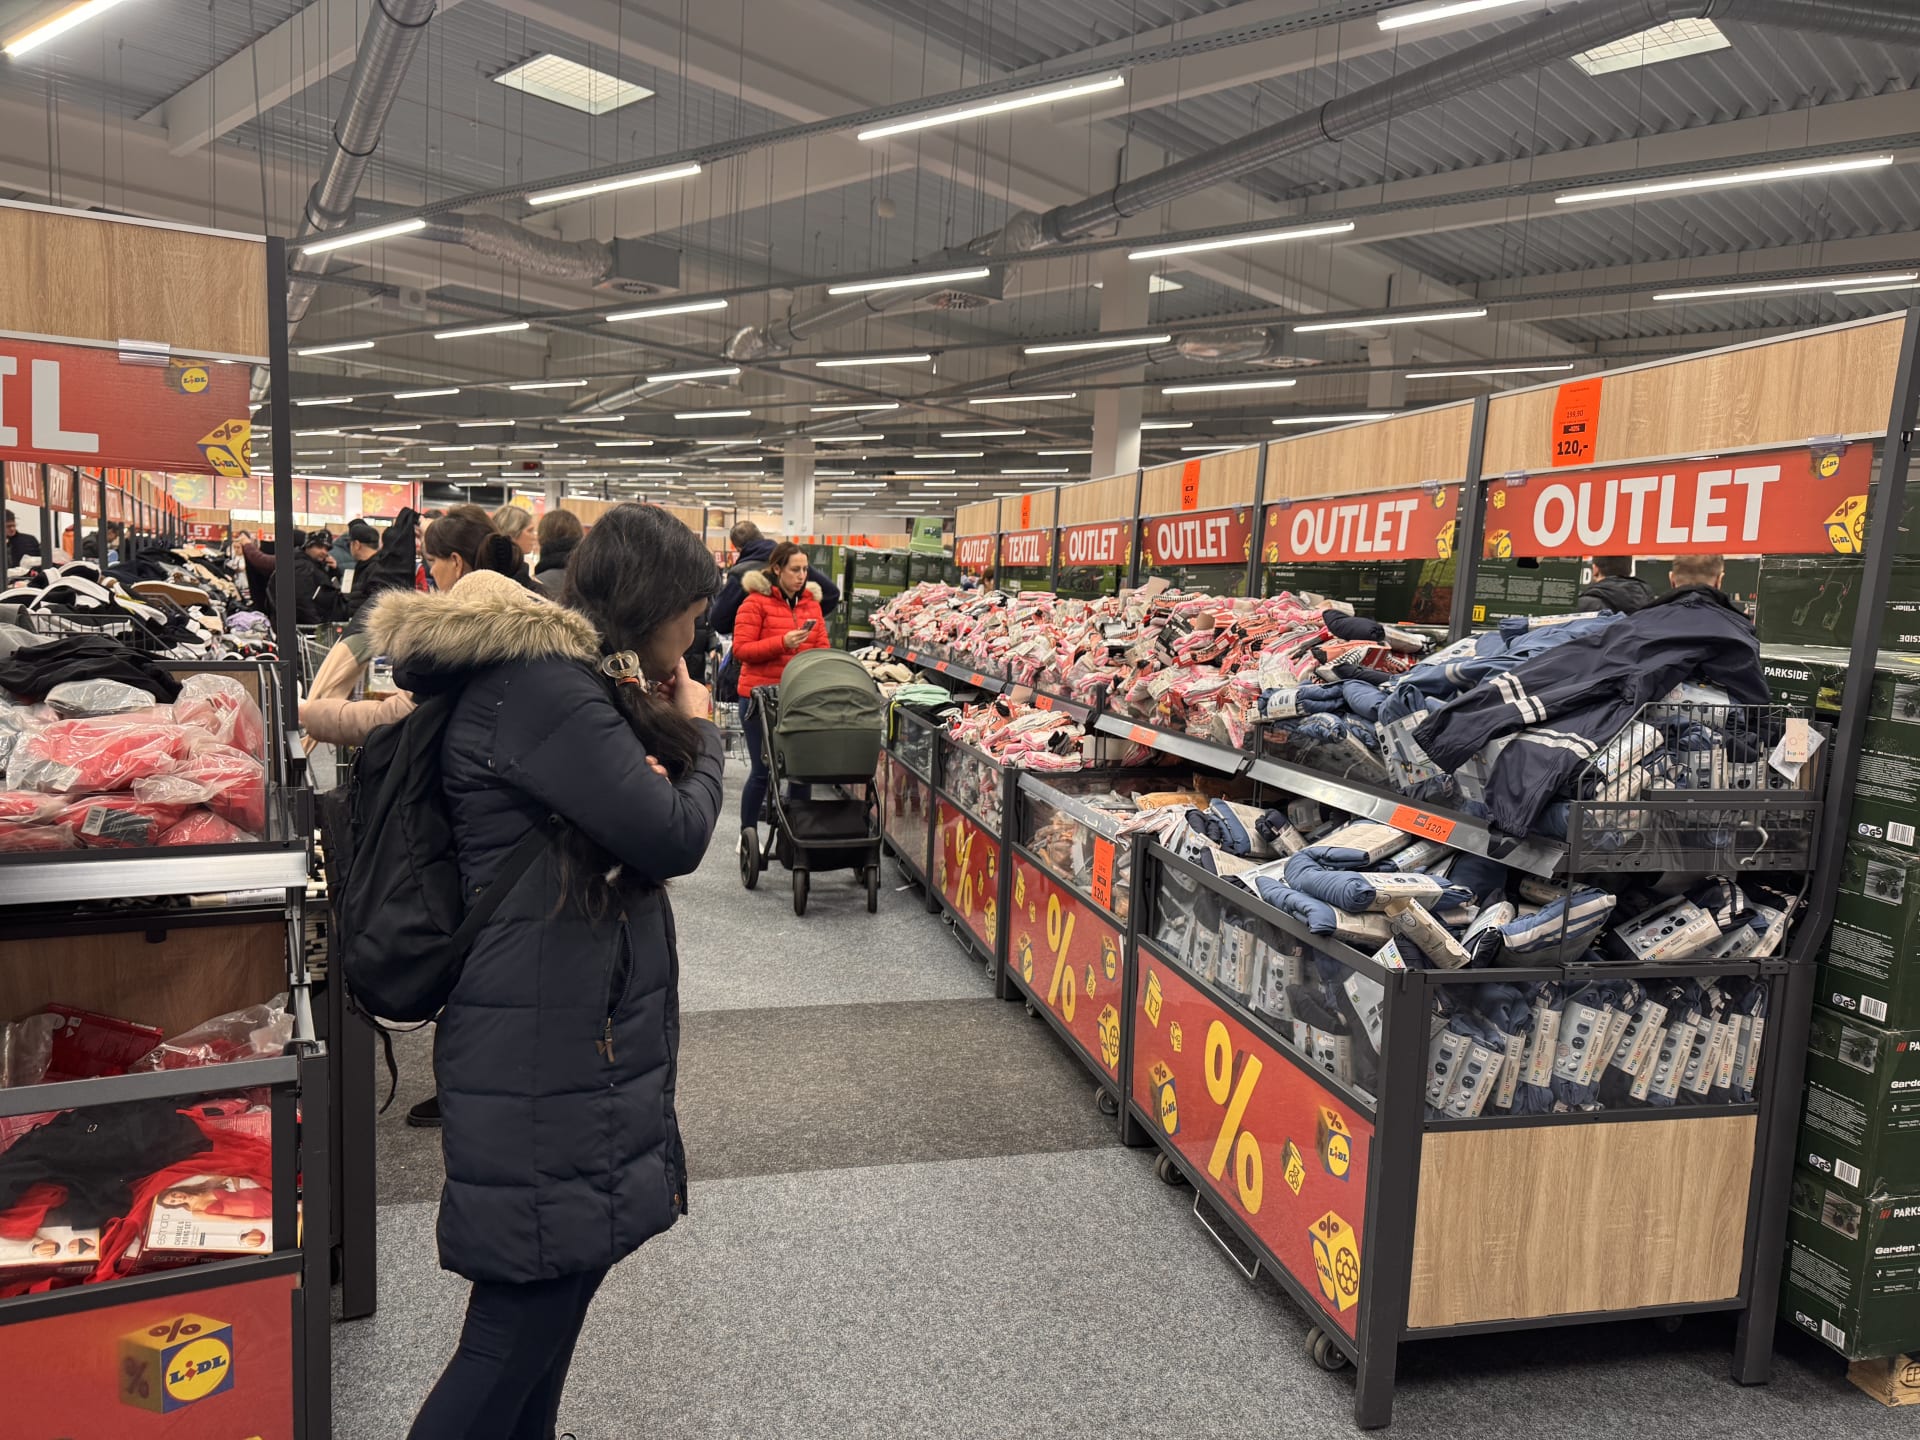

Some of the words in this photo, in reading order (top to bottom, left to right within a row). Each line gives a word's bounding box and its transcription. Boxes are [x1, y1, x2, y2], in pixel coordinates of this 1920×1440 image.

[1557, 440, 1589, 456] 120,-
[1533, 465, 1781, 548] OUTLET
[1157, 517, 1230, 560] OUTLET
[1290, 499, 1418, 555] OUTLET
[961, 539, 990, 563] OUTLET
[1009, 535, 1040, 562] TEXTIL
[1069, 528, 1118, 561] OUTLET
[1764, 666, 1809, 681] PARKSIDE
[1426, 822, 1446, 835] 120,-
[1875, 1244, 1915, 1255] Garden
